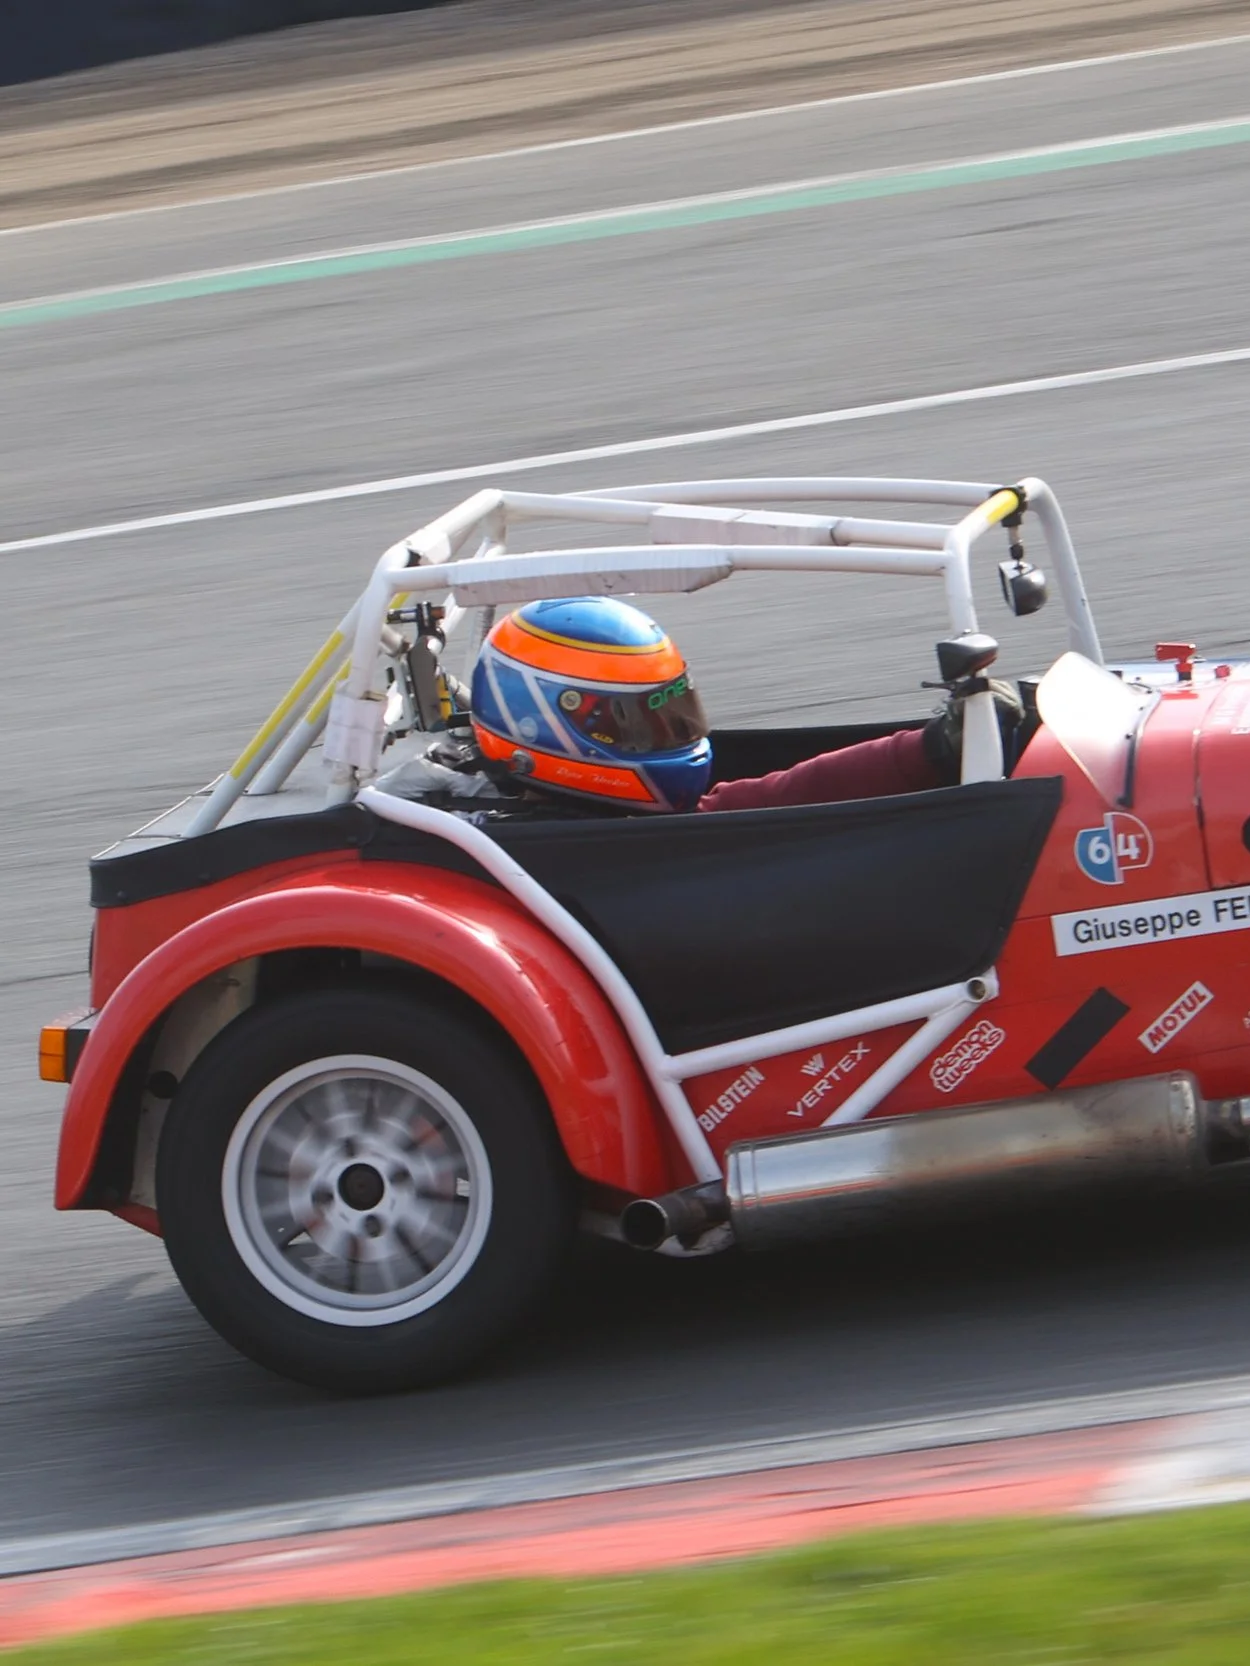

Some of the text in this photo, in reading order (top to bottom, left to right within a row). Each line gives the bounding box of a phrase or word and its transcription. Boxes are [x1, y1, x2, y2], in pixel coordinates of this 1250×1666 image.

[1087, 833, 1141, 865] 64
[1073, 908, 1201, 945] Giuseppe
[1147, 988, 1208, 1047] MOTUL
[787, 1041, 871, 1118] VERTEX
[931, 1021, 994, 1079] demon
[936, 1029, 1004, 1091] tweeks
[697, 1066, 766, 1132] BILSTEIN
